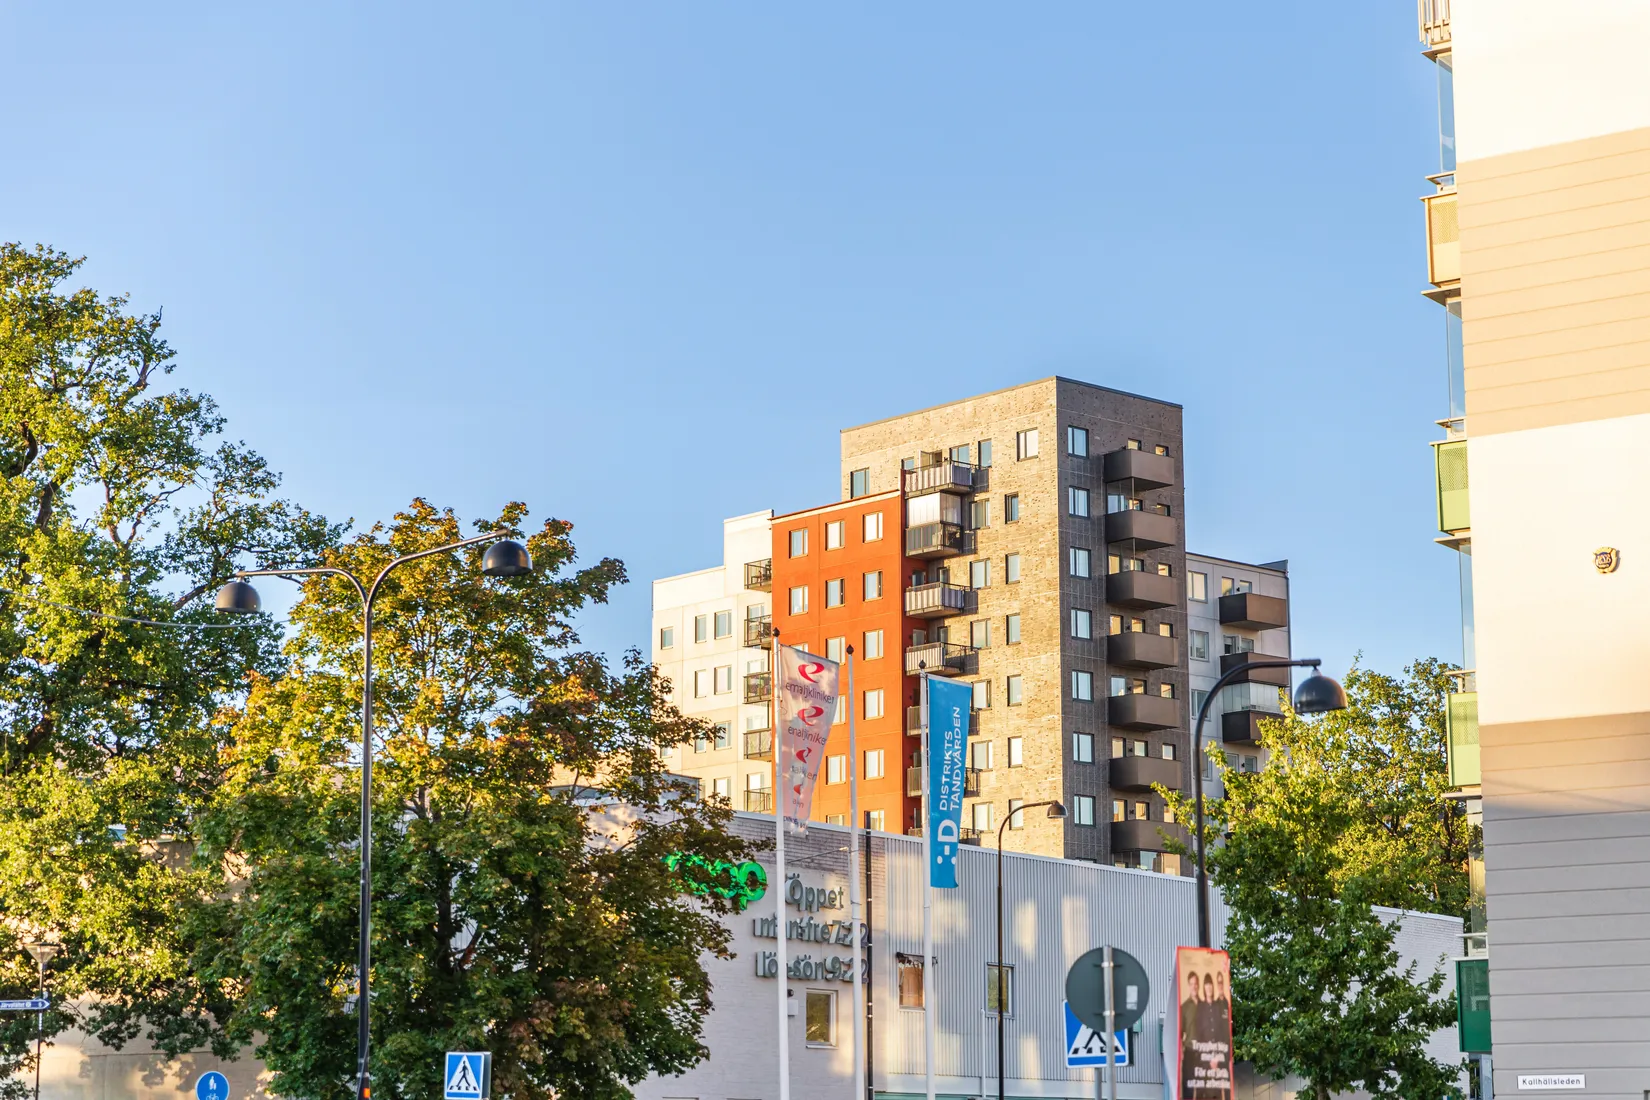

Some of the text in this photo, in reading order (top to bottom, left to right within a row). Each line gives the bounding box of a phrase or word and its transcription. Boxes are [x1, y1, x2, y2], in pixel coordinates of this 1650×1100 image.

[939, 730, 953, 811] DISTRIKTS
[950, 706, 962, 812] TANDVÅRDEN
[785, 872, 844, 912] Öppet
[1522, 1078, 1581, 1086] Kallhällsleden
